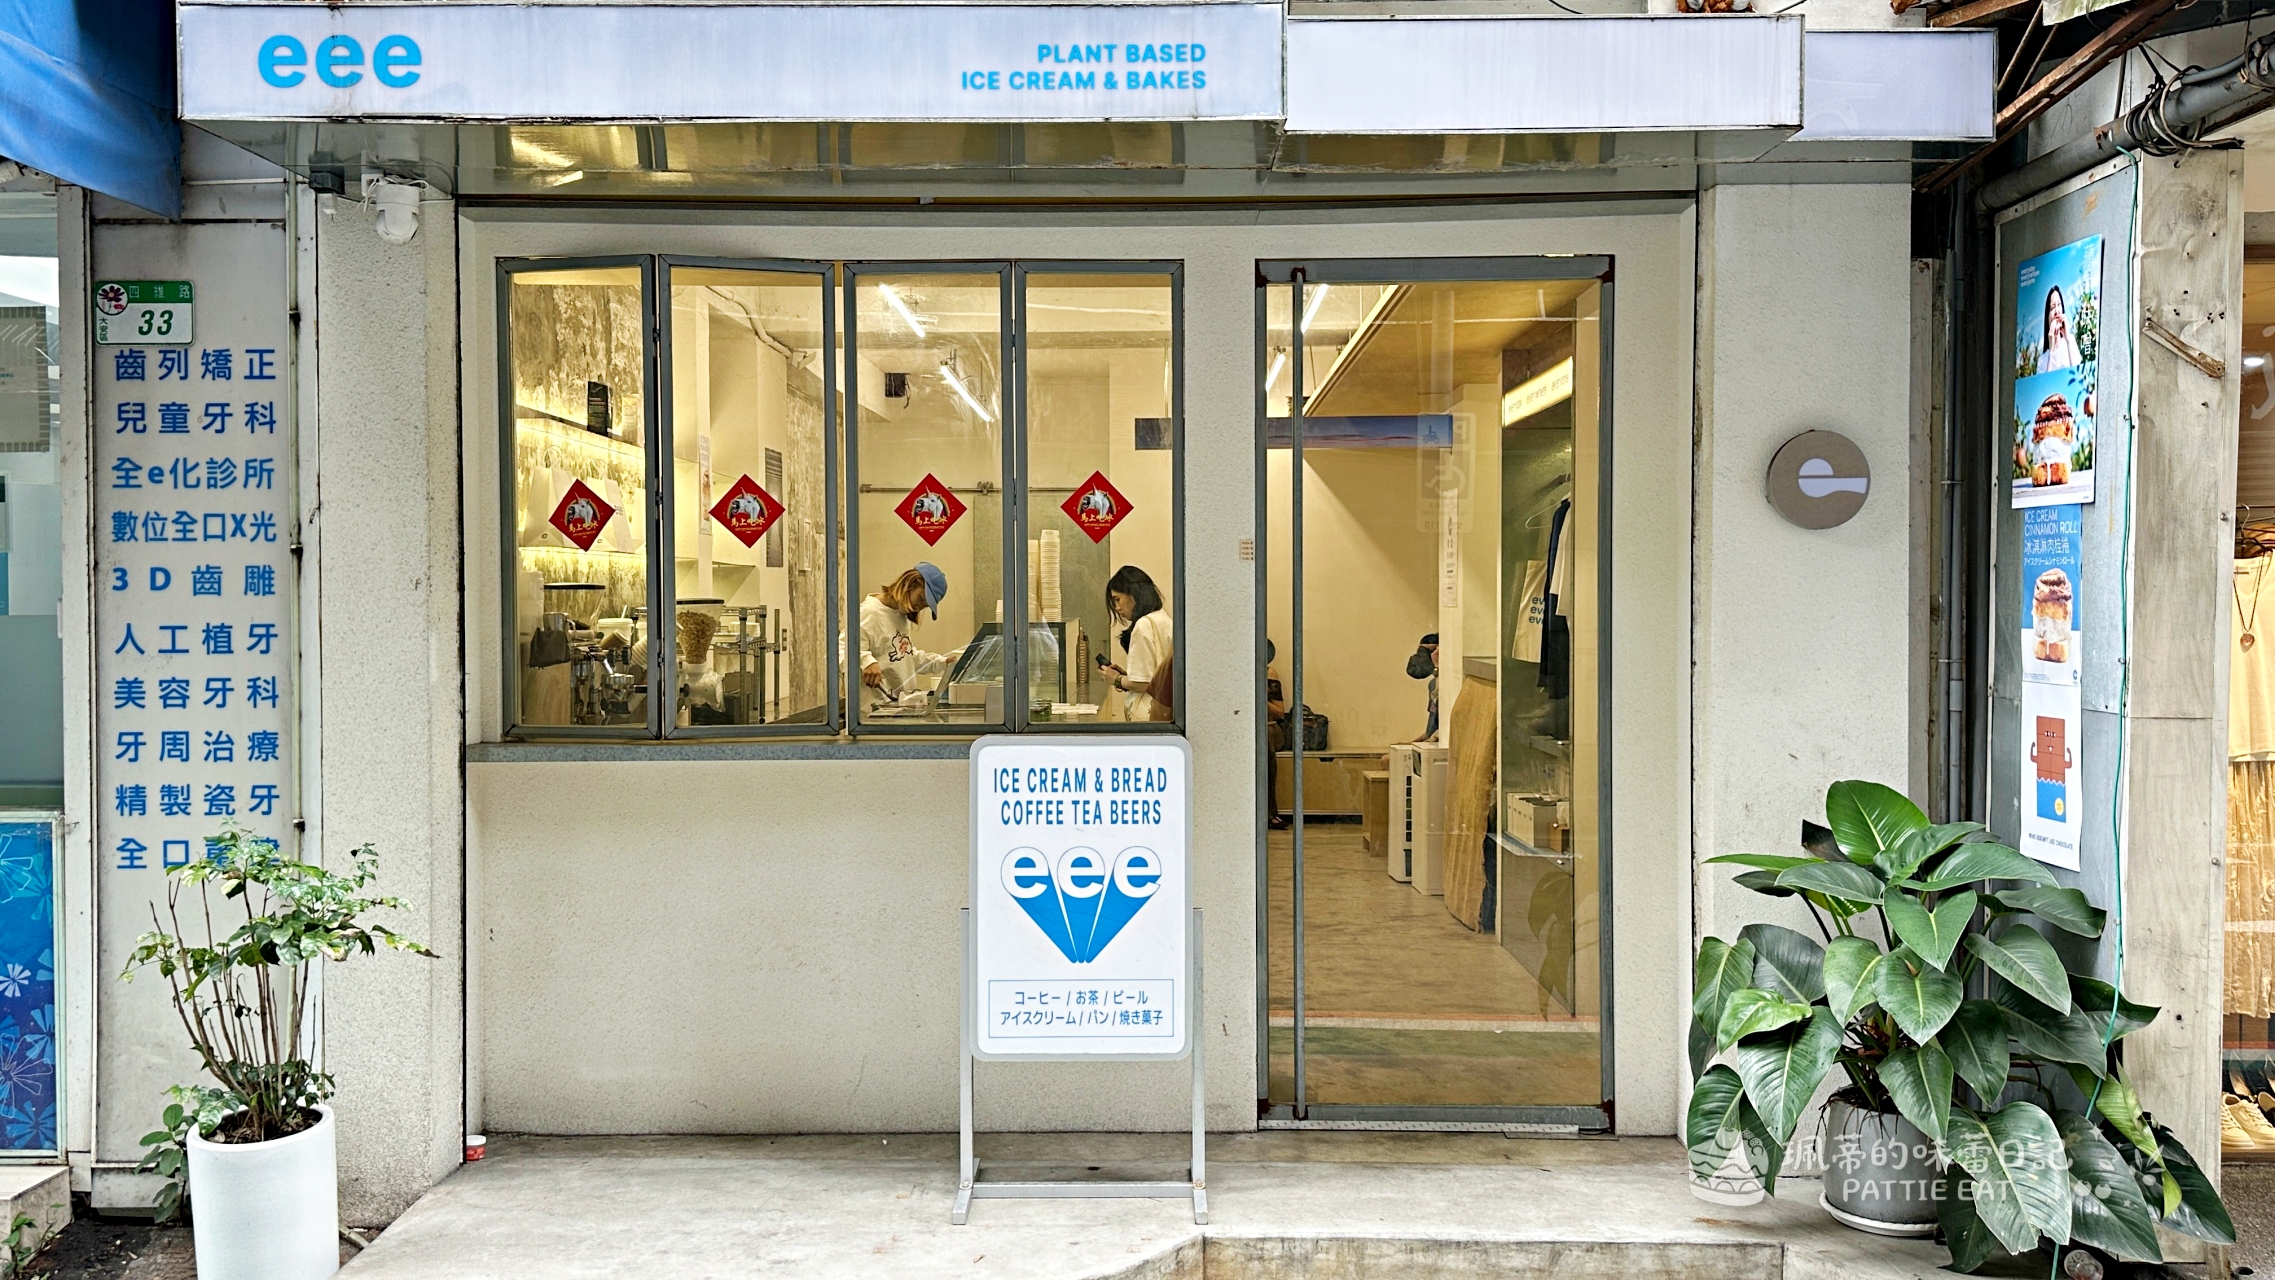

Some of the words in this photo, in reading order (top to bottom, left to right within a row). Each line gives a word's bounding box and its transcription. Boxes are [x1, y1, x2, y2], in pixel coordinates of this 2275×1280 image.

[258, 34, 422, 88] eee
[1038, 44, 1117, 63] PLANT
[1125, 44, 1206, 63] BASED
[962, 71, 1000, 90] ICE
[1009, 71, 1095, 90] CREAM
[1103, 71, 1118, 90] &
[1126, 71, 1206, 90] BAKES
[138, 310, 173, 336] 33
[115, 348, 276, 381] 齒列矯正
[116, 402, 277, 435] 兒童牙科
[112, 457, 275, 490] 全e化診所
[112, 511, 278, 543] 數位全口X光
[2024, 522, 2059, 537] CINNAMON
[2060, 521, 2078, 534] ROLL
[2025, 511, 2035, 523] ICE
[2036, 508, 2058, 522] CREAM
[115, 623, 279, 656] 人工植牙
[114, 677, 280, 710] 美容牙科
[115, 731, 280, 764] 牙周治療
[994, 768, 1020, 793] ICE
[1027, 767, 1087, 793] CREAM
[1094, 767, 1104, 793] &
[1111, 767, 1167, 793] BREAD
[115, 784, 281, 817] 精製瓷牙
[1001, 800, 1064, 825] COFFEE
[1072, 800, 1103, 825] TEA
[1110, 799, 1162, 825] BEERS
[1001, 846, 1162, 899] eee
